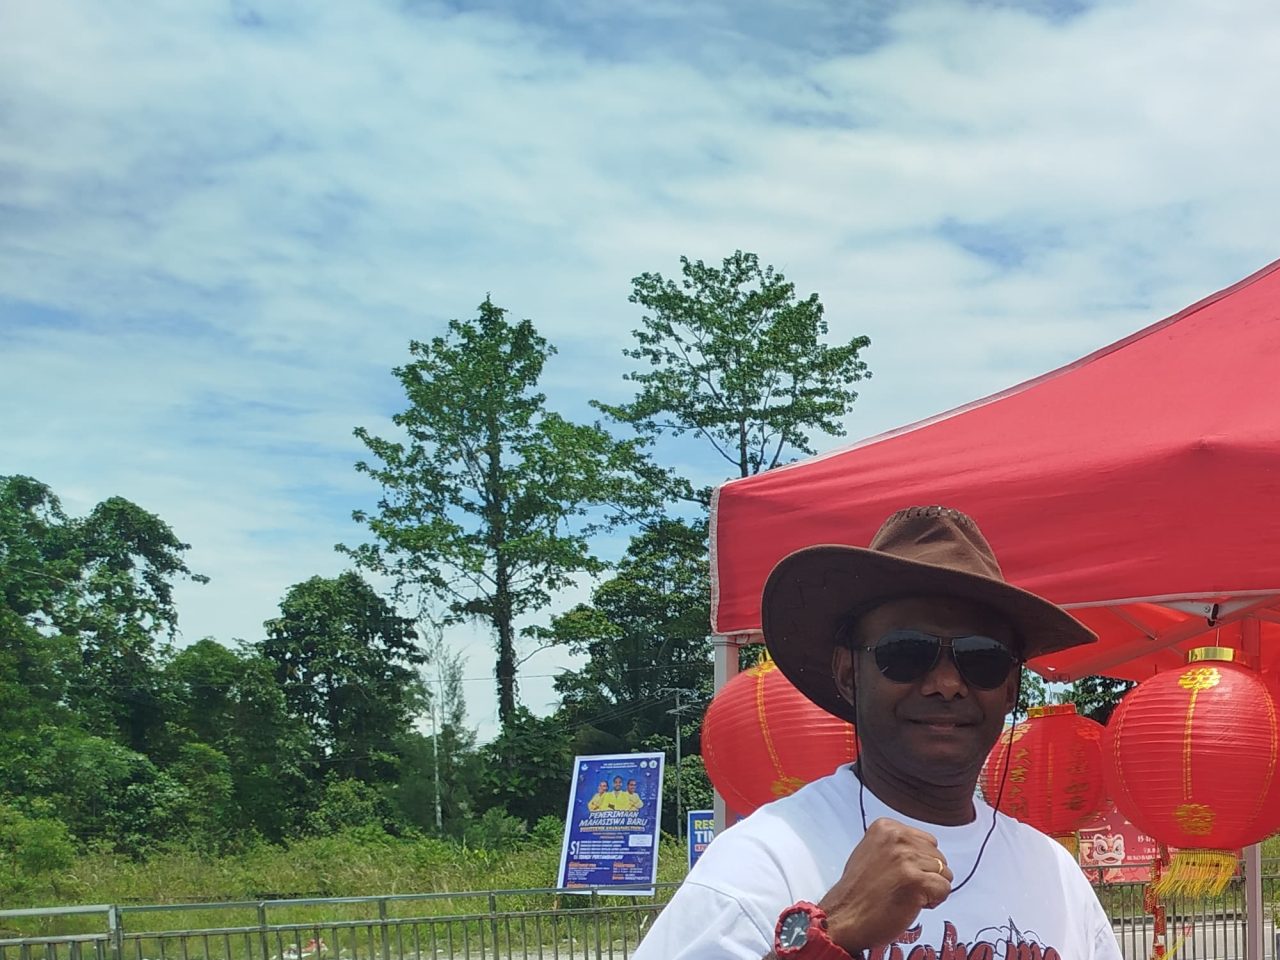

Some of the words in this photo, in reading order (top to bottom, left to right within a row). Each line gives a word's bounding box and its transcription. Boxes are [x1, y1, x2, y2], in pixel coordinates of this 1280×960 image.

[588, 811, 639, 820] PENERIMAAN
[578, 818, 626, 828] MAHASISWA
[626, 817, 648, 827] BARU
[694, 819, 715, 830] RES
